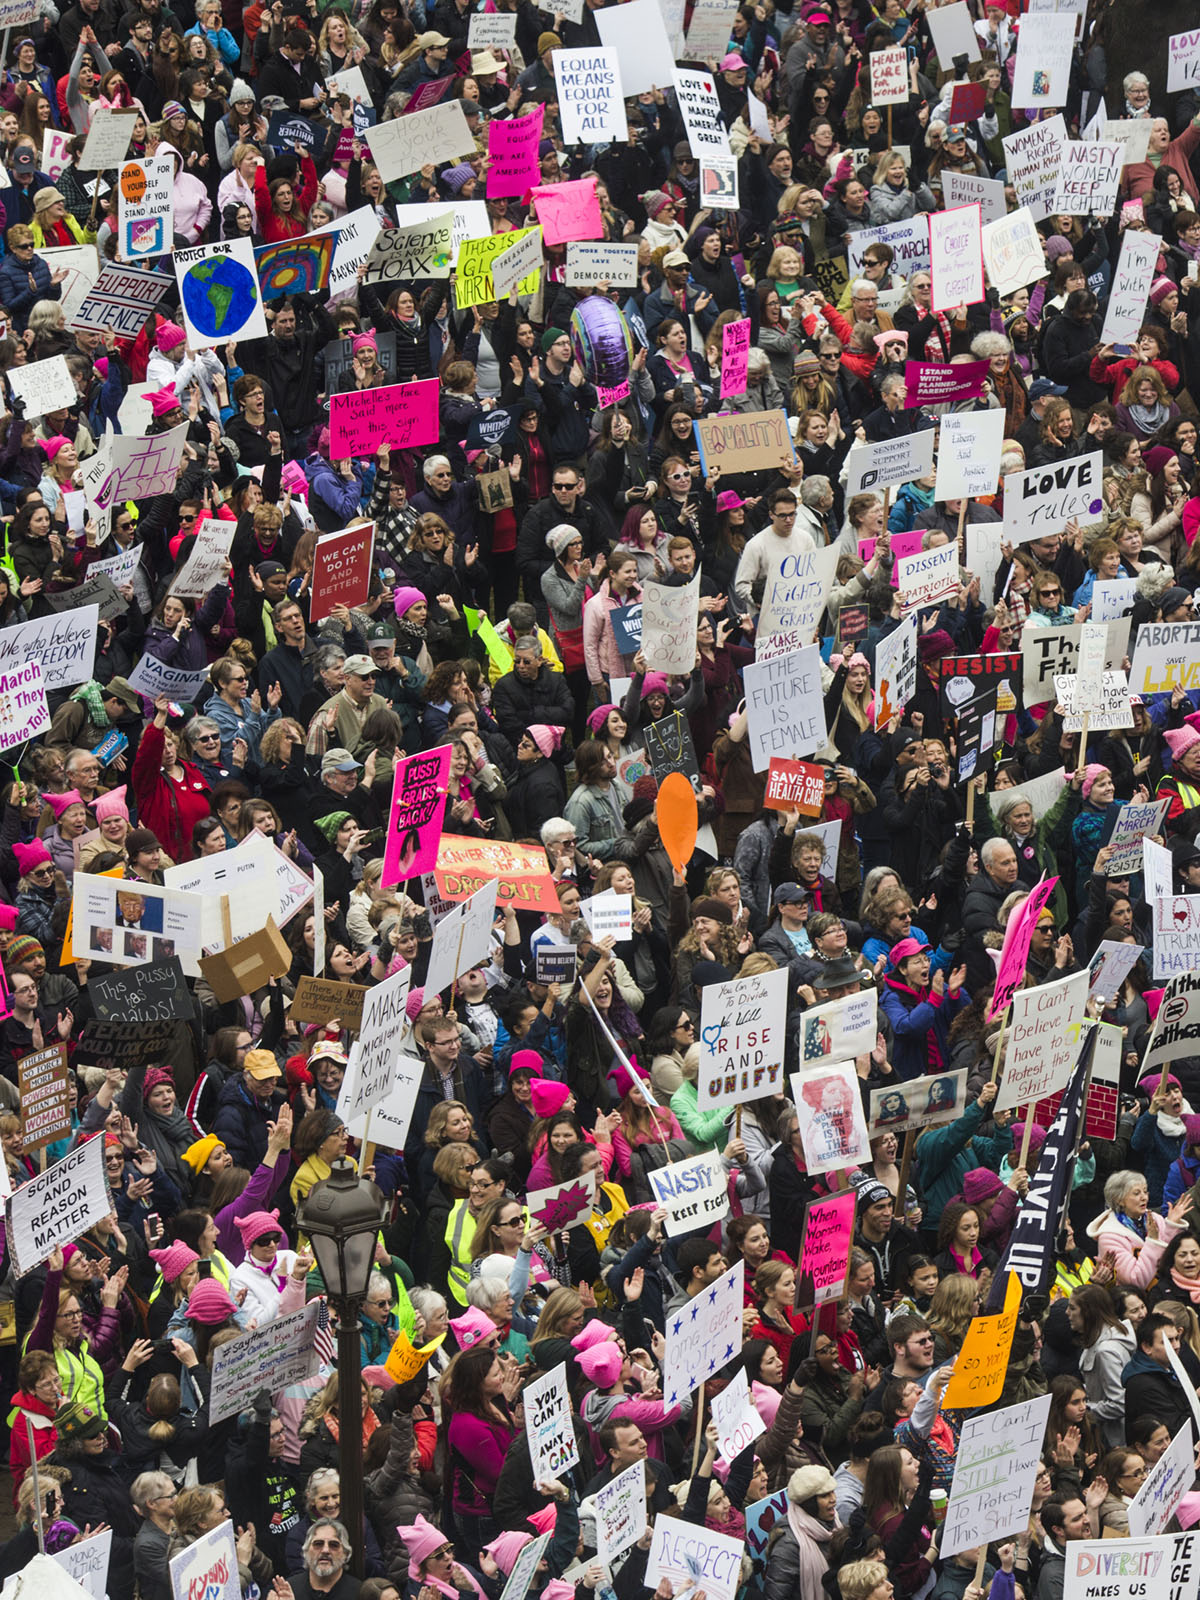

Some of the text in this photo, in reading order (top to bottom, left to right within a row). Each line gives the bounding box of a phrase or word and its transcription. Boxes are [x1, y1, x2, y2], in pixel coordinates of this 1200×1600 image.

[561, 58, 609, 71] EQUAL
[872, 53, 906, 67] HEALTH
[561, 72, 614, 86] MEANS
[873, 66, 900, 78] CARE
[565, 87, 611, 101] EQUAL
[680, 79, 701, 90] LOVE
[872, 84, 906, 97] WOMEN
[680, 91, 718, 107] NOT HATE
[576, 103, 608, 116] FOR
[688, 106, 715, 119] MAKES
[581, 117, 608, 130] ALL
[698, 132, 722, 145] GREAT
[1069, 148, 1118, 163] NASTY
[1060, 167, 1117, 182] WOMEN
[1063, 181, 1099, 194] KEEP
[124, 205, 170, 218] STAND ALONE
[1056, 196, 1114, 211] FIGHTING
[174, 244, 232, 263] PROTECT OUR
[464, 235, 514, 258] THIS IS
[366, 255, 432, 282] HOAX
[94, 276, 168, 302] SUPPORT
[77, 300, 148, 333] SCIENCE
[925, 369, 953, 377] STAND
[401, 389, 420, 397] face
[918, 382, 972, 394] PARENTHOOD
[919, 380, 955, 389] PLANNED
[478, 419, 511, 433] WHITMER
[702, 420, 782, 454] EQUALITY
[873, 441, 910, 455] SENIORS
[872, 452, 911, 466] SUPPORT
[878, 462, 910, 475] Planned
[878, 465, 922, 483] Parenthood
[1023, 461, 1092, 499] LOVE
[322, 543, 364, 563] WE CAN
[906, 550, 955, 574] DISSENT
[327, 558, 357, 572] DO IT.
[330, 568, 352, 582] AND
[319, 578, 361, 596] BETTER.
[904, 576, 957, 599] PATRIOTIC
[51, 621, 91, 643] believe
[763, 656, 799, 677] THE
[941, 655, 1019, 676] RESIST
[1166, 657, 1186, 665] SAVES
[0, 663, 41, 691] March
[15, 688, 44, 707] They
[752, 674, 811, 706] FUTURE
[772, 705, 788, 724] IS
[1, 708, 50, 748] Have To!!
[760, 717, 818, 751] FEMALE
[407, 760, 439, 784] PUSSY
[772, 771, 824, 789] SAVE OUR
[401, 786, 437, 807] GRABS
[768, 782, 822, 808] HEALTH CARE
[96, 981, 126, 1000] This
[1024, 998, 1030, 1016] I
[1014, 1016, 1061, 1042] Believe
[718, 1029, 771, 1053] RISE
[1014, 1035, 1062, 1063] have to
[709, 1063, 780, 1098] UNIFY
[1008, 1060, 1044, 1084] Protest
[22, 1080, 66, 1106] POWERFUL
[356, 1075, 389, 1108] AGAIN
[26, 1108, 64, 1130] WOMAN
[23, 1120, 69, 1144] DETERMINED
[28, 1152, 86, 1198] SCIENCE
[653, 1166, 712, 1201] NASTY
[43, 1179, 71, 1205] AND
[31, 1187, 87, 1231] REASON
[672, 1205, 698, 1220] KEEP
[809, 1208, 837, 1223] When
[34, 1205, 91, 1248] MATTER
[807, 1224, 841, 1240] Women
[535, 1386, 557, 1408] YOU
[533, 1399, 563, 1428] CAN'T
[991, 1405, 1032, 1430] Can't
[539, 1432, 564, 1458] AWAY
[549, 1439, 574, 1470] GAY
[1077, 1552, 1162, 1577] DIVERSITY
[1087, 1584, 1146, 1596] MAKES US
